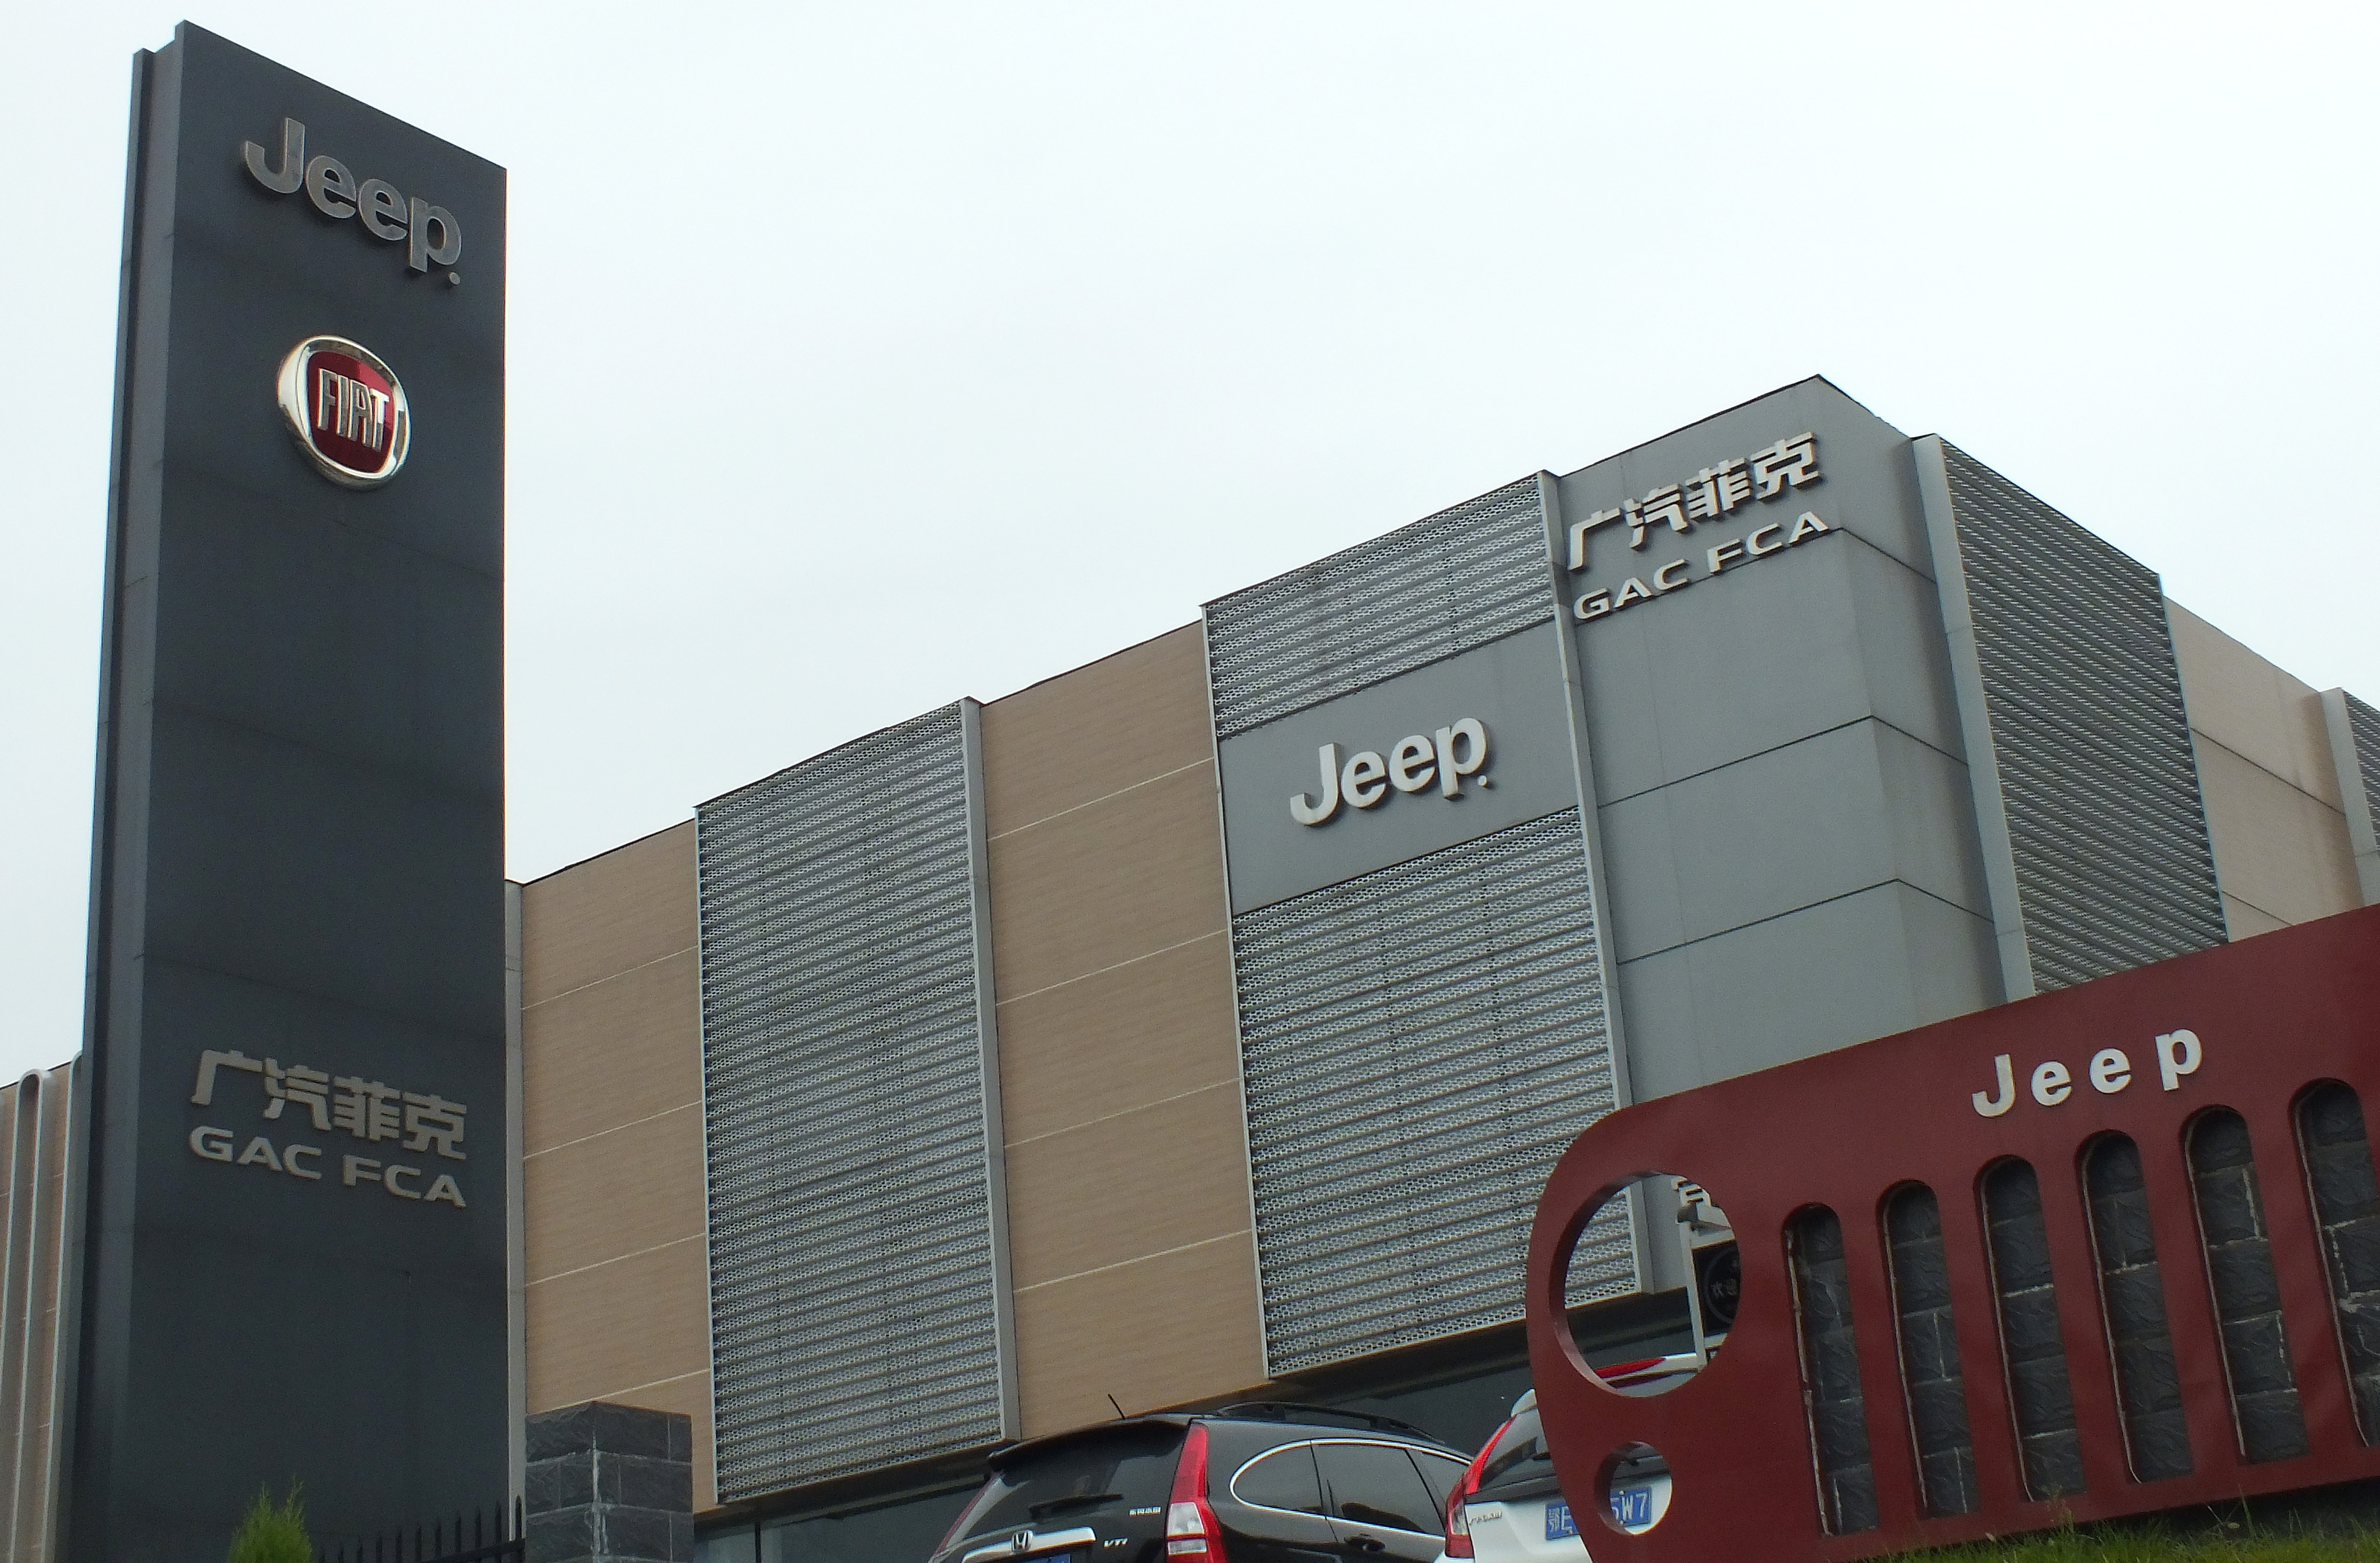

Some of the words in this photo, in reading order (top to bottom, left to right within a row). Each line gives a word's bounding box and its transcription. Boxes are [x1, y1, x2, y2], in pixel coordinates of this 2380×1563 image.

[317, 368, 389, 451] FIAT
[1569, 431, 1821, 570] 广汽菲克
[1572, 558, 1689, 620] GAC
[1706, 510, 1830, 573] FCA
[191, 1050, 467, 1160] 广汽菲克
[1971, 1028, 2202, 1118] Jeep
[190, 1125, 322, 1179] GAC
[343, 1154, 466, 1208] FCA
